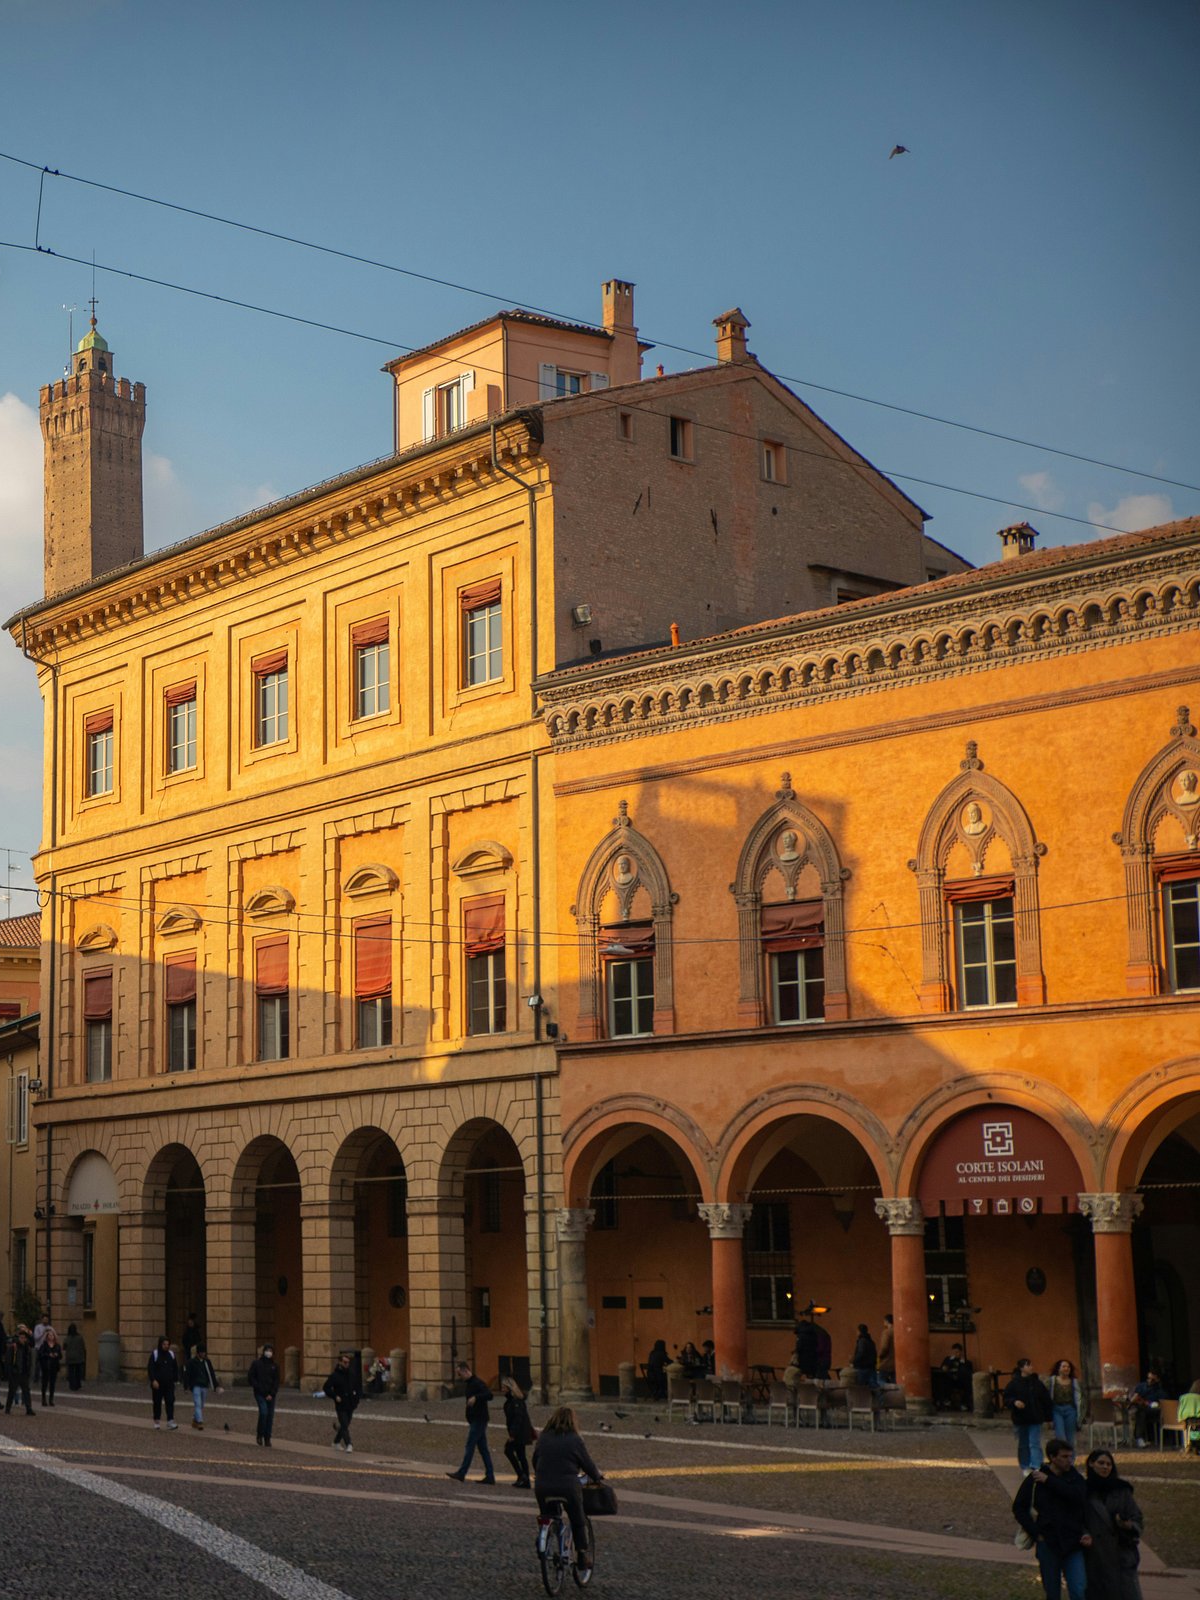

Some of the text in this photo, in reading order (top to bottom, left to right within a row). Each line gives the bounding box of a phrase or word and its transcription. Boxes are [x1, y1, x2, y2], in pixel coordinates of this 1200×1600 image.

[956, 1160, 1044, 1174] CORTE ISOLANI
[1012, 1174, 1045, 1182] DESIDERI
